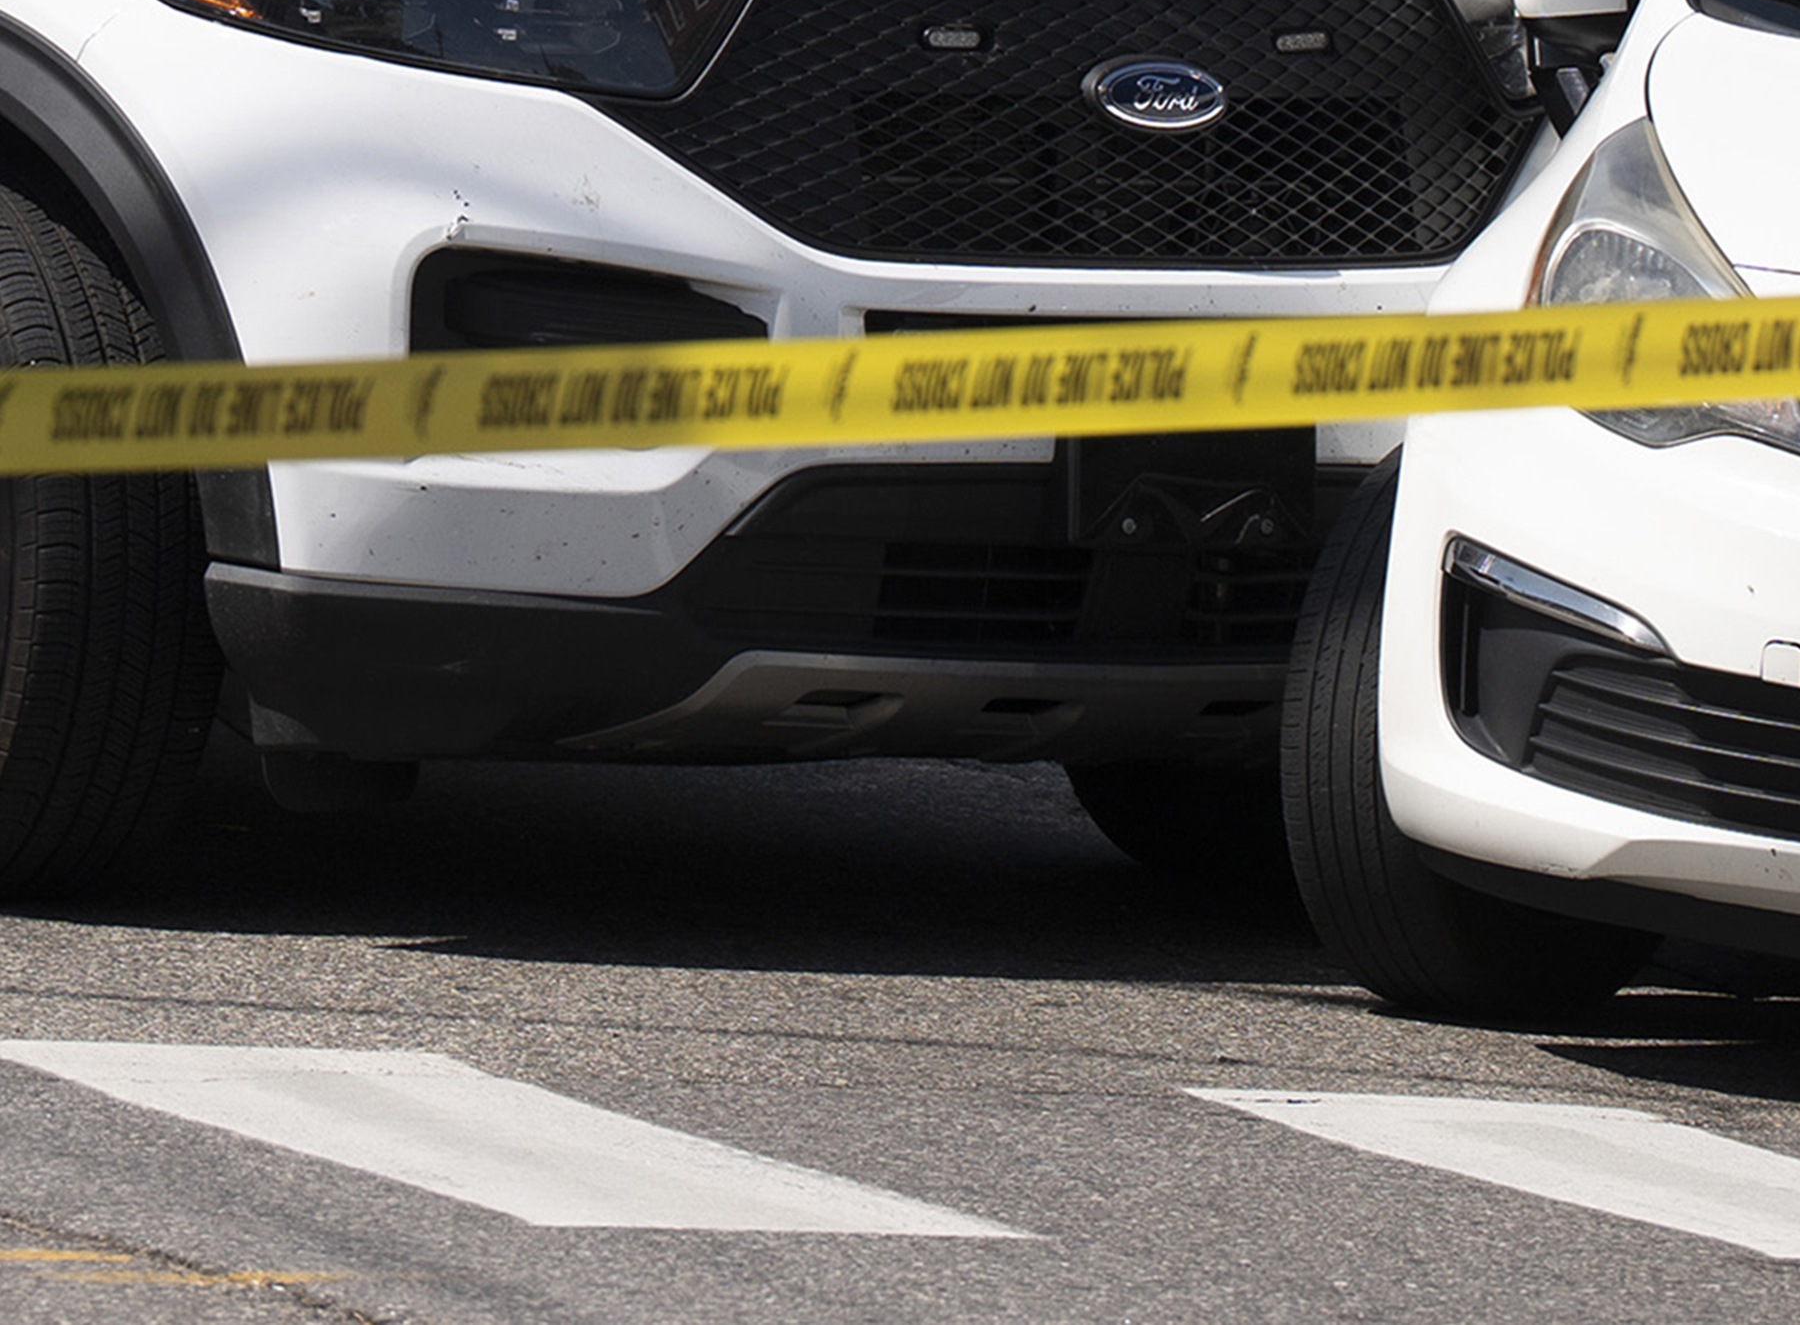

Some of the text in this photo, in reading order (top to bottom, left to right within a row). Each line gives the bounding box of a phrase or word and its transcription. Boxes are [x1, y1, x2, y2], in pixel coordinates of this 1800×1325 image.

[1133, 75, 1200, 112] Ford
[1291, 341, 1366, 396] CROSS
[1367, 339, 1413, 391] NOT
[1414, 337, 1449, 389] DO
[1450, 334, 1501, 386] LINE
[1502, 326, 1582, 385] POLICE
[1678, 320, 1751, 377] CROSS
[1751, 318, 1798, 371] NOT
[476, 370, 558, 428] CROSS
[557, 368, 608, 425] NOT
[608, 366, 648, 423] DO
[646, 364, 702, 421] LINE
[702, 362, 790, 420] POLICE
[891, 358, 969, 411] CROSS
[969, 356, 1017, 409] NOT
[1018, 354, 1054, 406] DO
[1055, 351, 1107, 404] LINE
[1109, 346, 1192, 403] POLICE
[50, 384, 135, 441] CROSS
[135, 382, 188, 439] NOT
[187, 380, 227, 437] DO
[225, 379, 284, 436] LINE
[284, 376, 377, 435] POLICE
